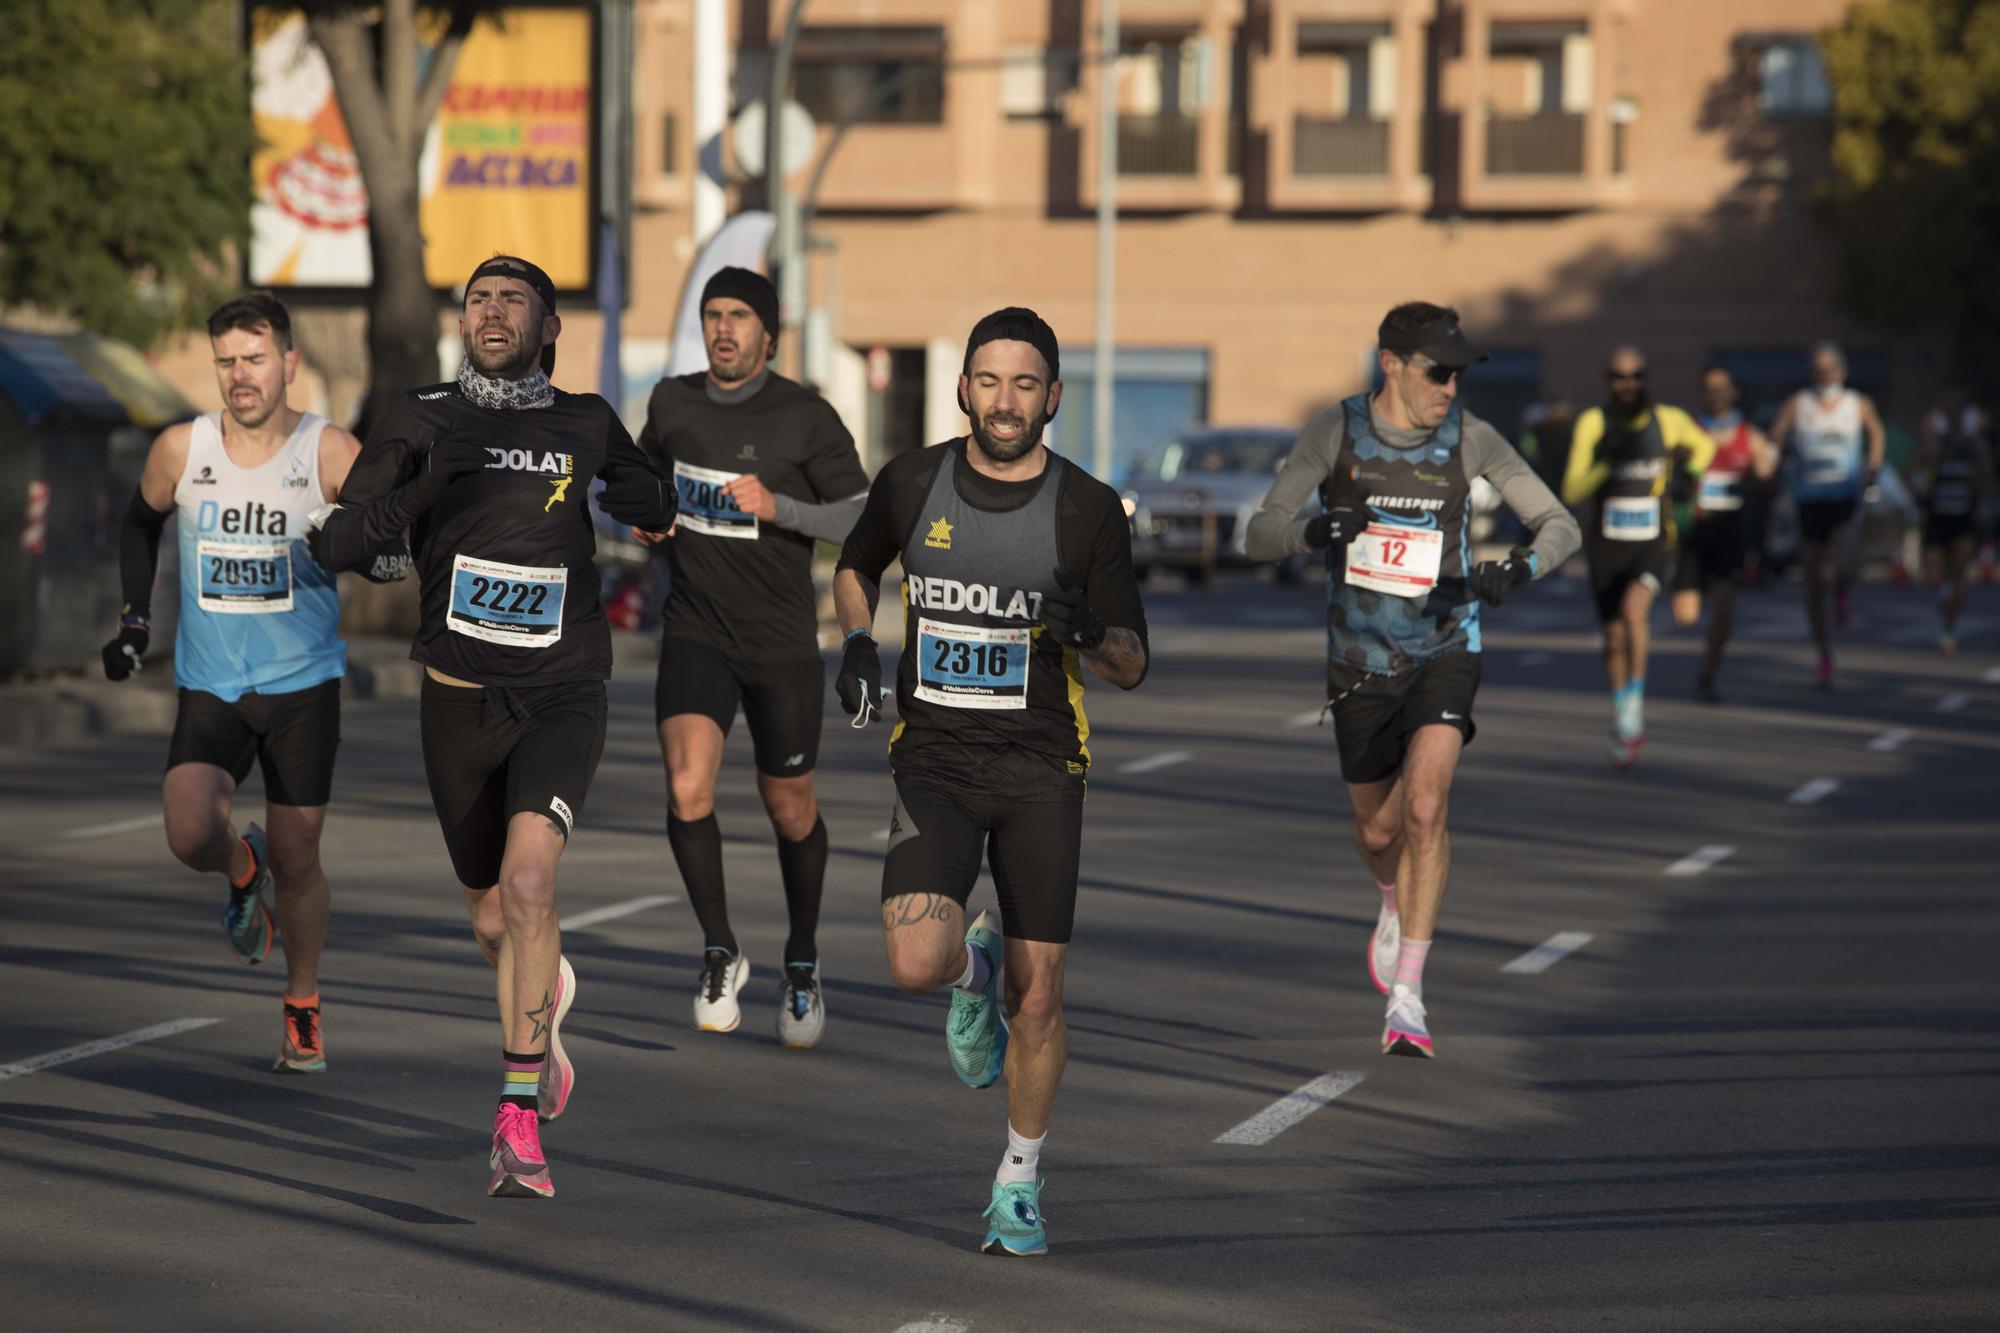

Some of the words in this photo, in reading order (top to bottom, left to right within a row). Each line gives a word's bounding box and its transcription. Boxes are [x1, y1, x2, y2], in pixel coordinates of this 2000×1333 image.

[484, 447, 567, 475] DOLAT
[281, 475, 309, 488] Delta
[197, 500, 287, 536] Delta
[1381, 540, 1408, 567] 12
[210, 557, 277, 586] 2059
[469, 577, 548, 615] 2222
[908, 573, 1044, 621] REDOLAT
[934, 639, 1008, 677] 2316
